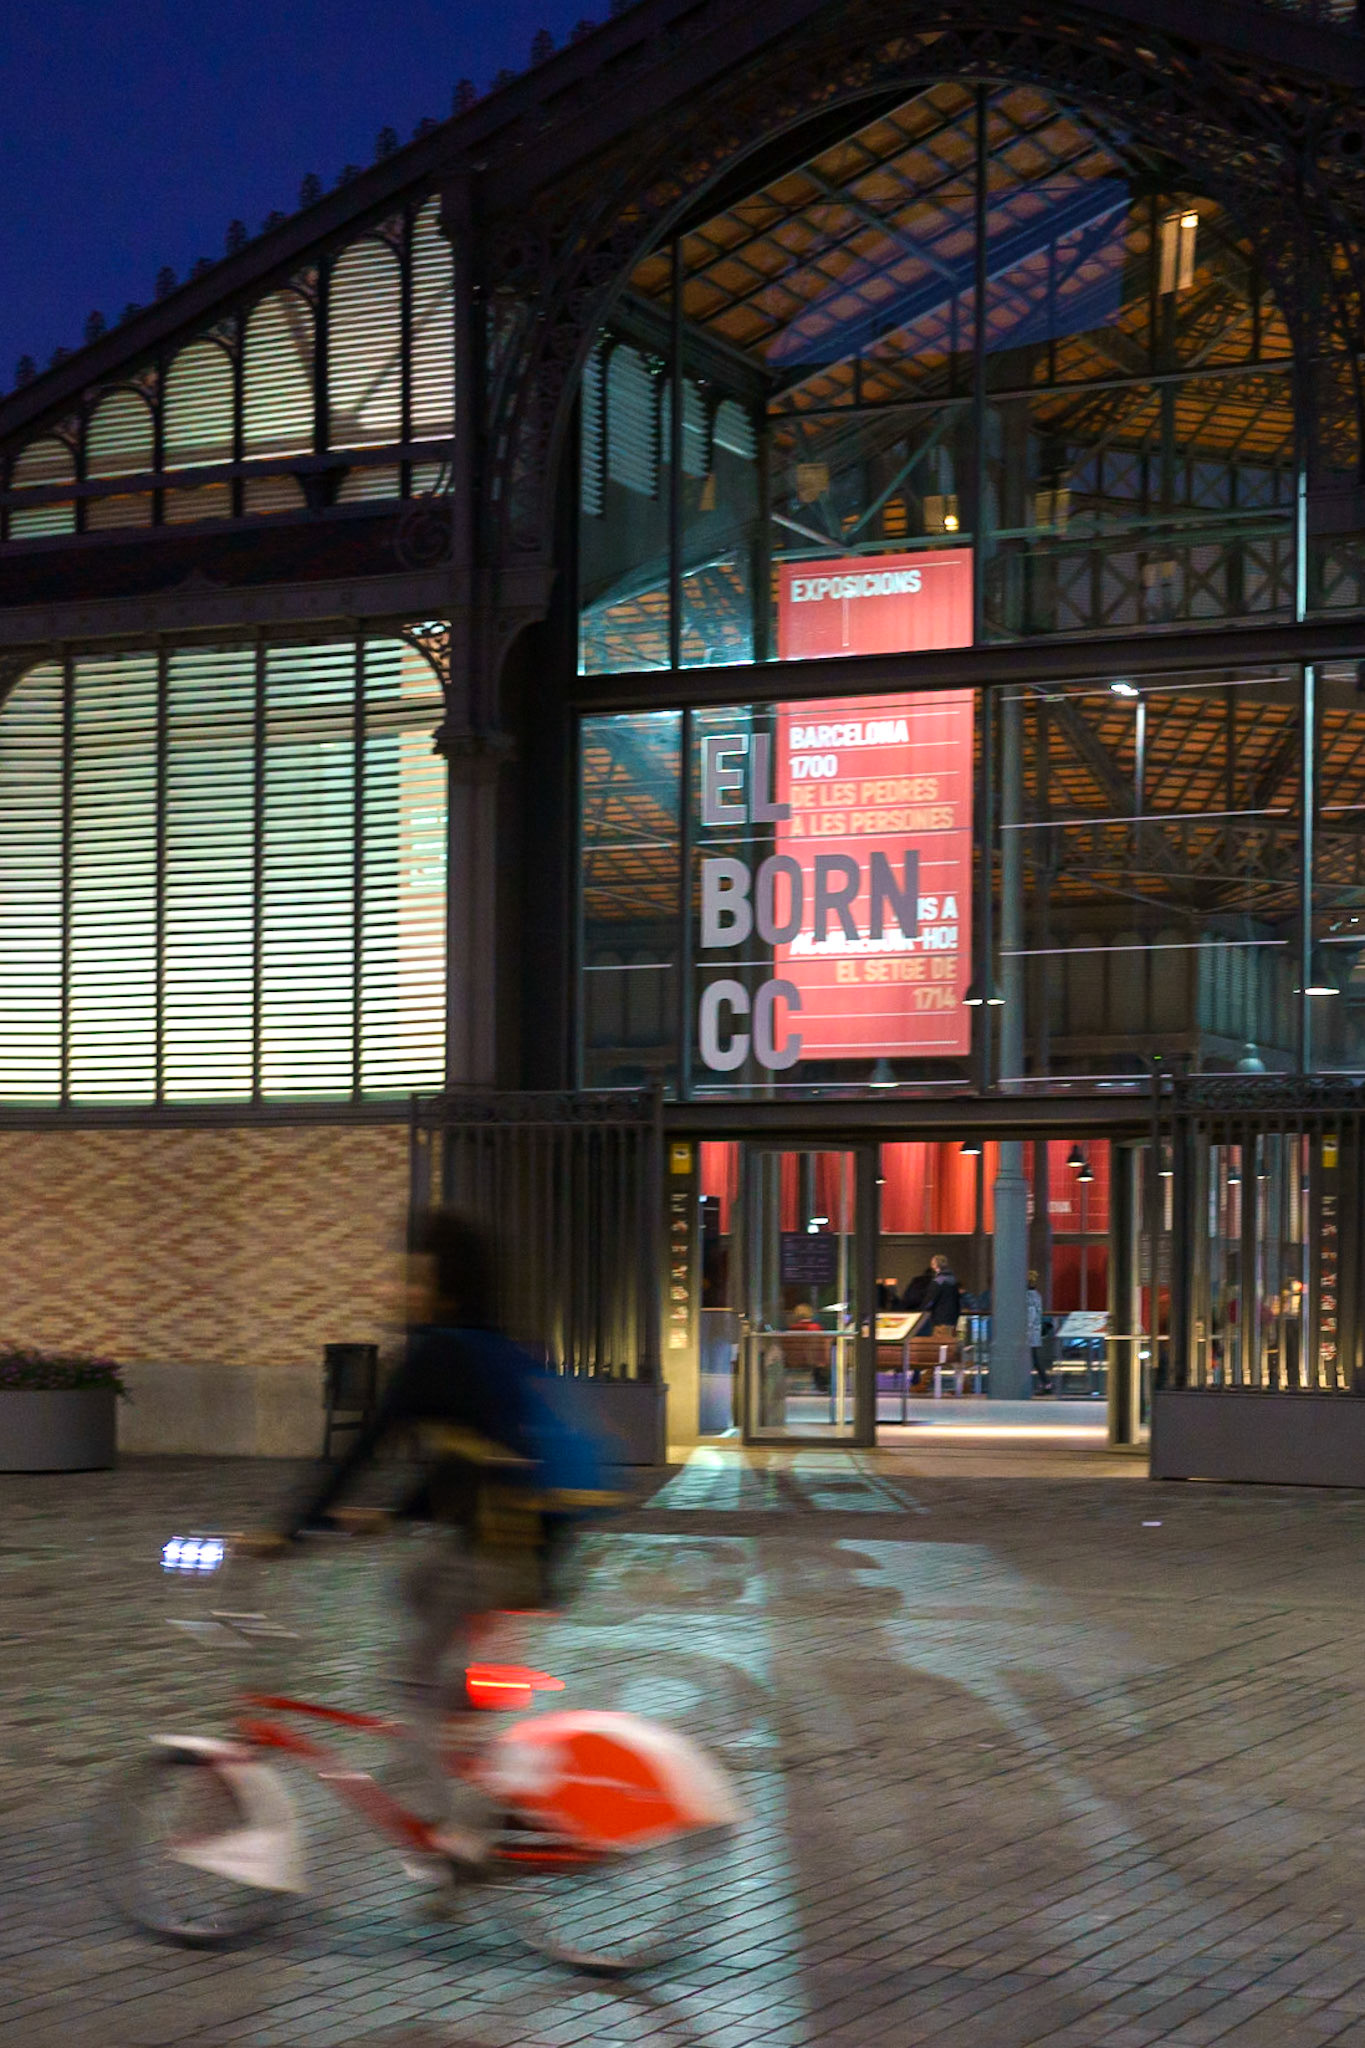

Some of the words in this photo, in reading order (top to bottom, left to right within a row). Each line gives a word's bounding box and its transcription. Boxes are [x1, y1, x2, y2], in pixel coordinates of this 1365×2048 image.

[791, 570, 922, 602] EXPOSICIONS
[790, 720, 909, 749] BARCELONA
[701, 734, 792, 827] EL
[790, 755, 838, 778] 1700
[791, 786, 816, 808] DE
[820, 783, 857, 806] LES
[861, 778, 938, 804] PEDRES
[792, 814, 805, 837] A
[809, 812, 847, 836] LES
[852, 807, 954, 834] PERSONES
[700, 850, 919, 948] BORN
[836, 960, 859, 983] EL
[864, 958, 926, 982] SETGE
[931, 956, 958, 979] DE
[913, 987, 957, 1009] 1714
[700, 979, 803, 1071] CC
